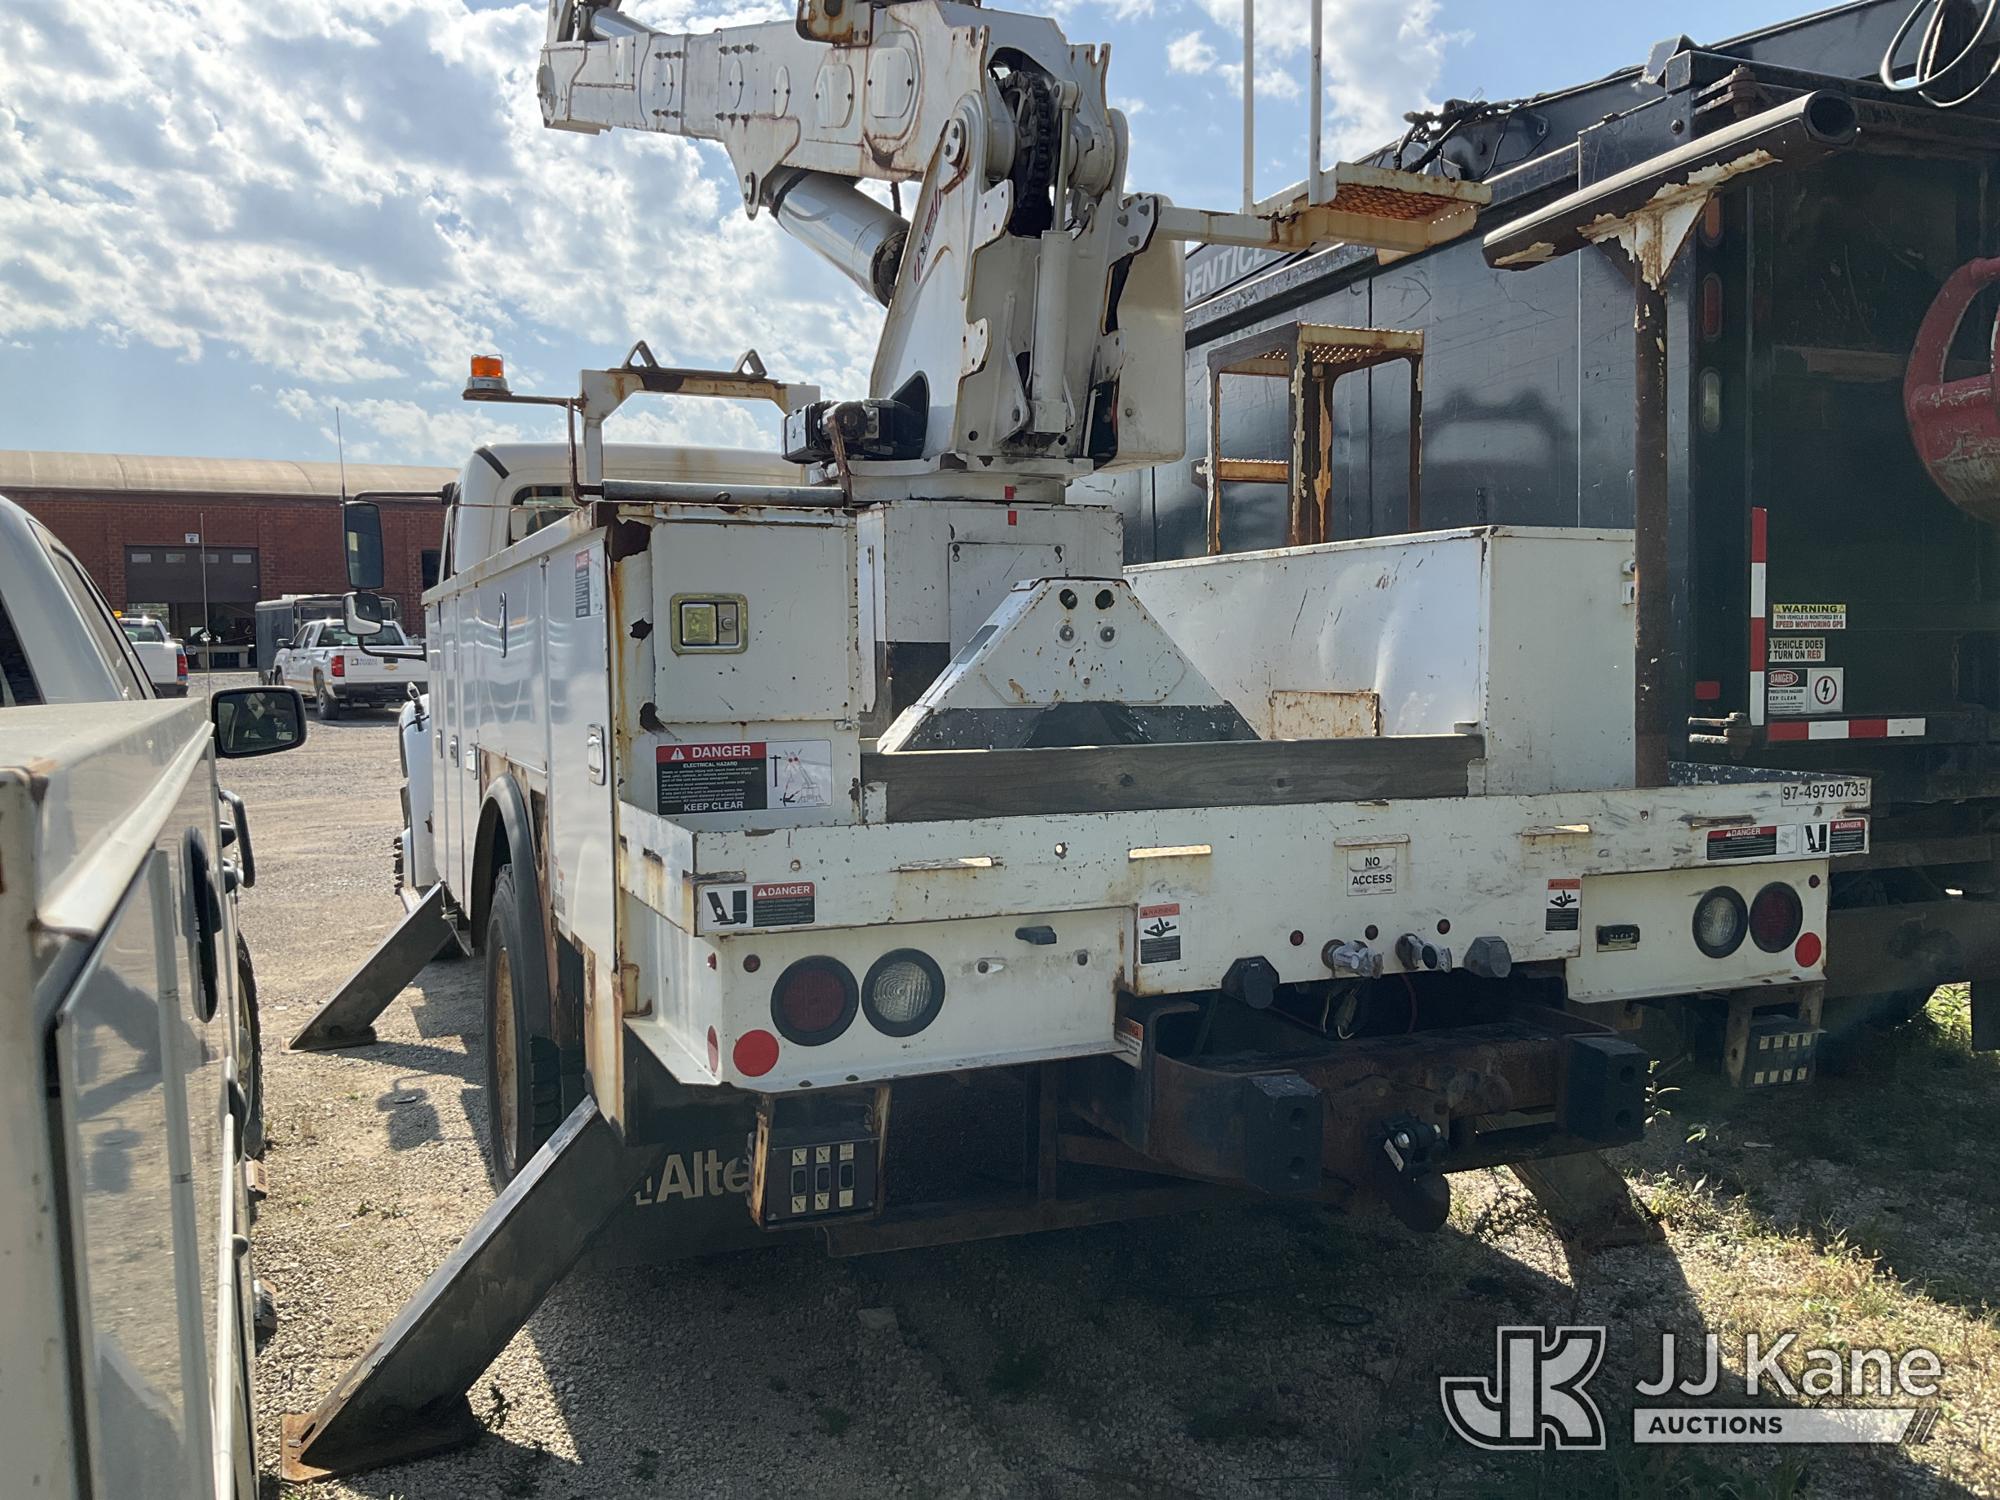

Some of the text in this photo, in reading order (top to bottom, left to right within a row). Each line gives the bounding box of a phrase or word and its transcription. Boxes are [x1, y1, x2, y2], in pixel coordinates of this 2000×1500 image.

[1782, 605, 1838, 613] WARNING
[1773, 640, 1803, 649] VEHICLE
[1805, 640, 1823, 649] DOES
[1774, 651, 1793, 659] TURN
[1795, 651, 1805, 659] ON
[1808, 650, 1821, 659] RED
[1770, 674, 1793, 683] DANGER
[692, 745, 751, 758] DANGER
[1783, 783, 1866, 800] 97-49790735
[684, 801, 743, 812] KEEP CLEAR
[1731, 827, 1760, 836] DANGER
[1365, 857, 1380, 866] NO
[1352, 874, 1392, 885] ACCESS
[768, 886, 810, 896] DANGER
[656, 1150, 749, 1203] Alte
